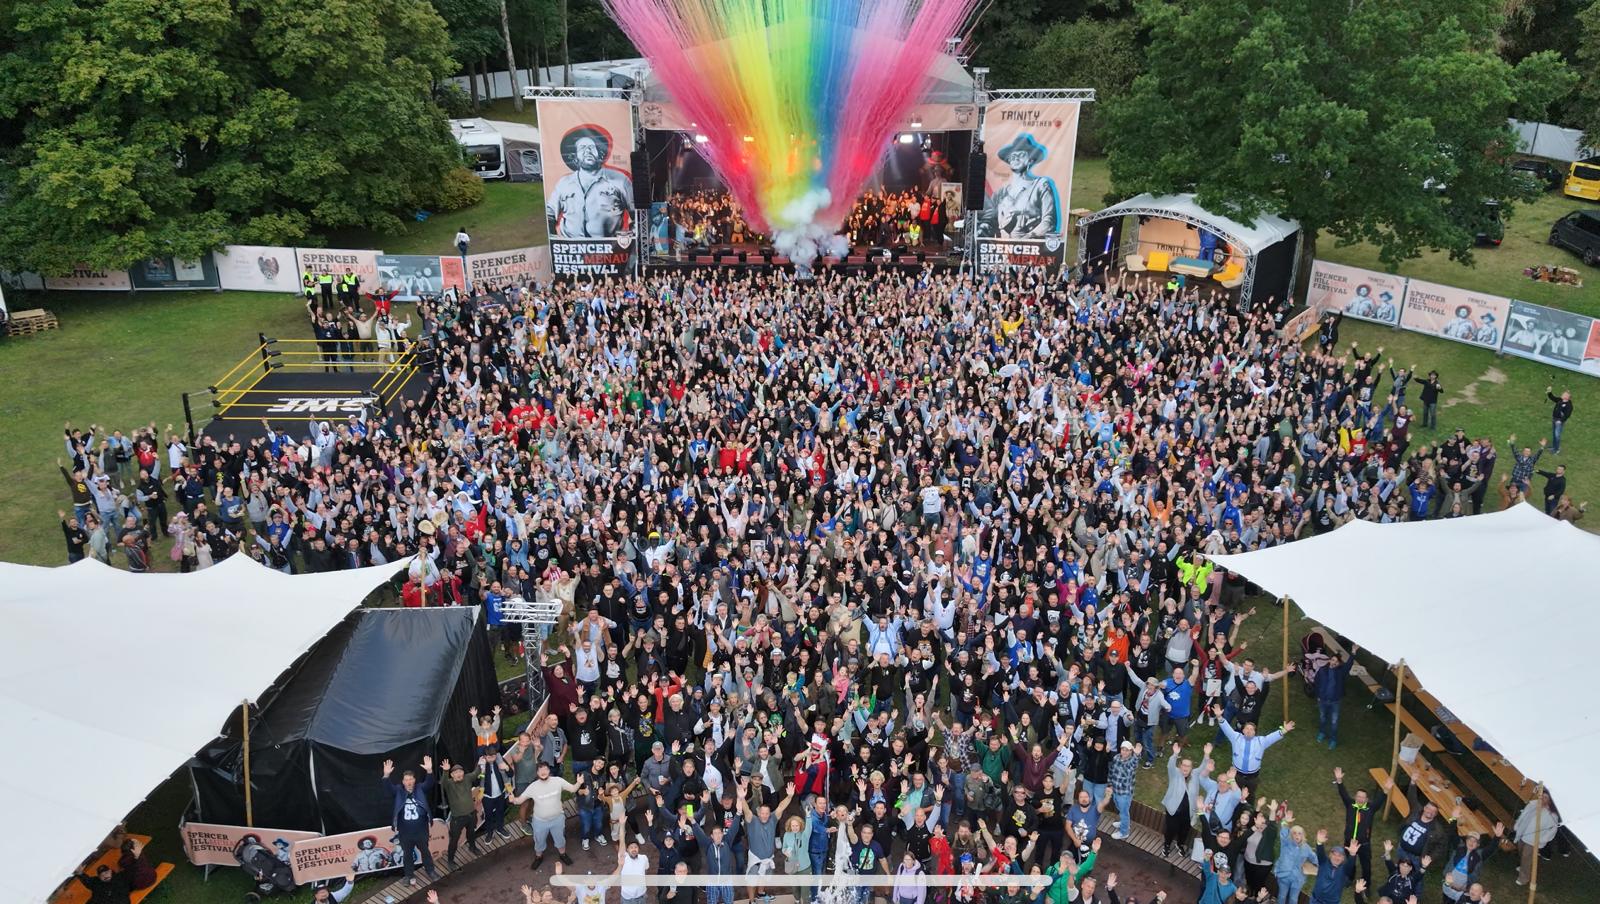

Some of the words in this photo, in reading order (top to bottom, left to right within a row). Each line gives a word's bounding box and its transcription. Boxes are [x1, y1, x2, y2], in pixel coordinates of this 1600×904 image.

[1001, 110, 1040, 121] TRINITY
[553, 243, 613, 254] SPENCER
[980, 243, 1040, 255] SPENCER
[303, 254, 359, 264] SPENCER
[472, 254, 527, 269] SPENCER
[554, 264, 619, 275] FESTIVAL
[1315, 272, 1348, 283] SPENCER
[1312, 283, 1348, 295] FESTIVAL
[1410, 290, 1446, 302] SPENCER
[1408, 302, 1446, 315] FESTIVAL
[404, 803, 419, 820] 63
[1402, 826, 1422, 846] 63
[295, 844, 342, 858] SPENCER
[297, 857, 348, 871] FESTIVAL
